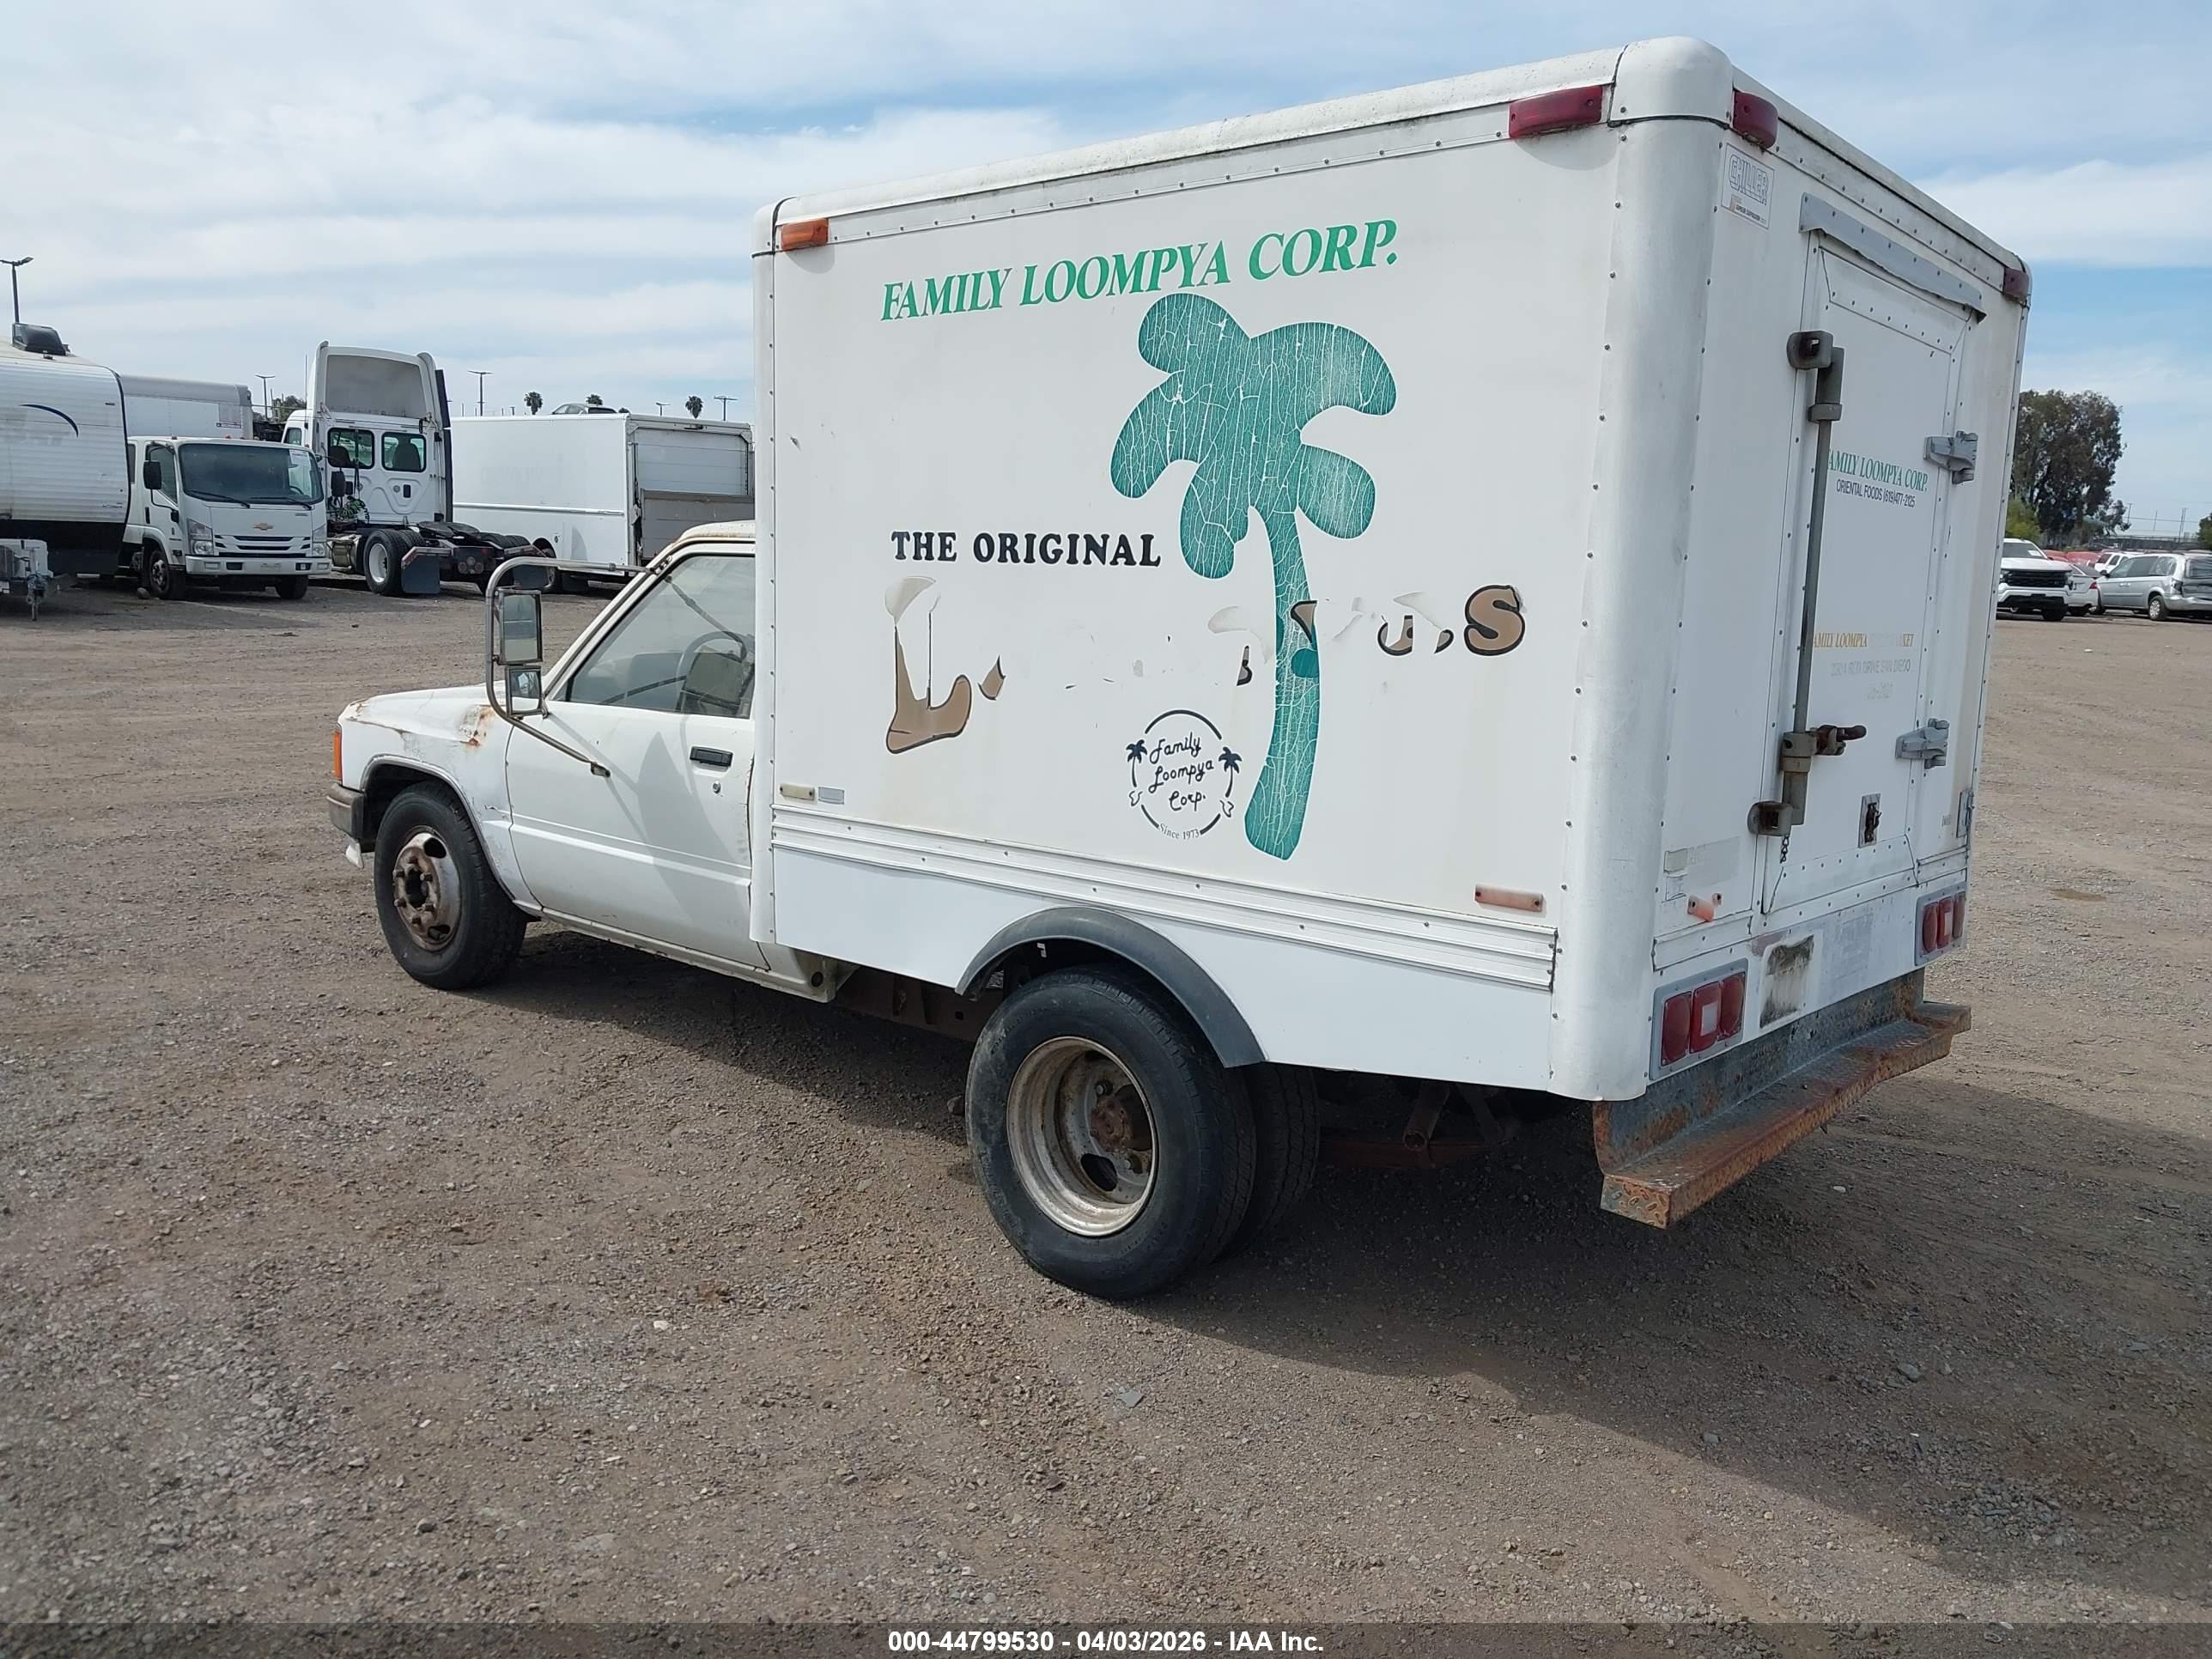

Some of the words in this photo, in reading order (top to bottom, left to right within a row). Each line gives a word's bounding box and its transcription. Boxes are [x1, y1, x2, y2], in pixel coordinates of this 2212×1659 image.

[1729, 155, 1767, 205] CHILLER
[880, 266, 1012, 322] FAMILY
[1019, 240, 1231, 307] LOOMPYA
[1249, 219, 1399, 281] CORP.
[1827, 450, 1859, 475] AMILY
[1860, 457, 1903, 486] LOOMPYA
[1905, 469, 1929, 492] CORP.
[1836, 479, 1863, 497] ORIENTAL
[1863, 484, 1883, 501] FOODS
[890, 530, 957, 562] THE
[973, 532, 1162, 568] ORIGINAL
[1150, 732, 1201, 764] Family
[1148, 760, 1213, 793] Loompya
[1168, 790, 1206, 812] Corp.
[1158, 823, 1180, 840] Since
[1182, 828, 1200, 841] 1973
